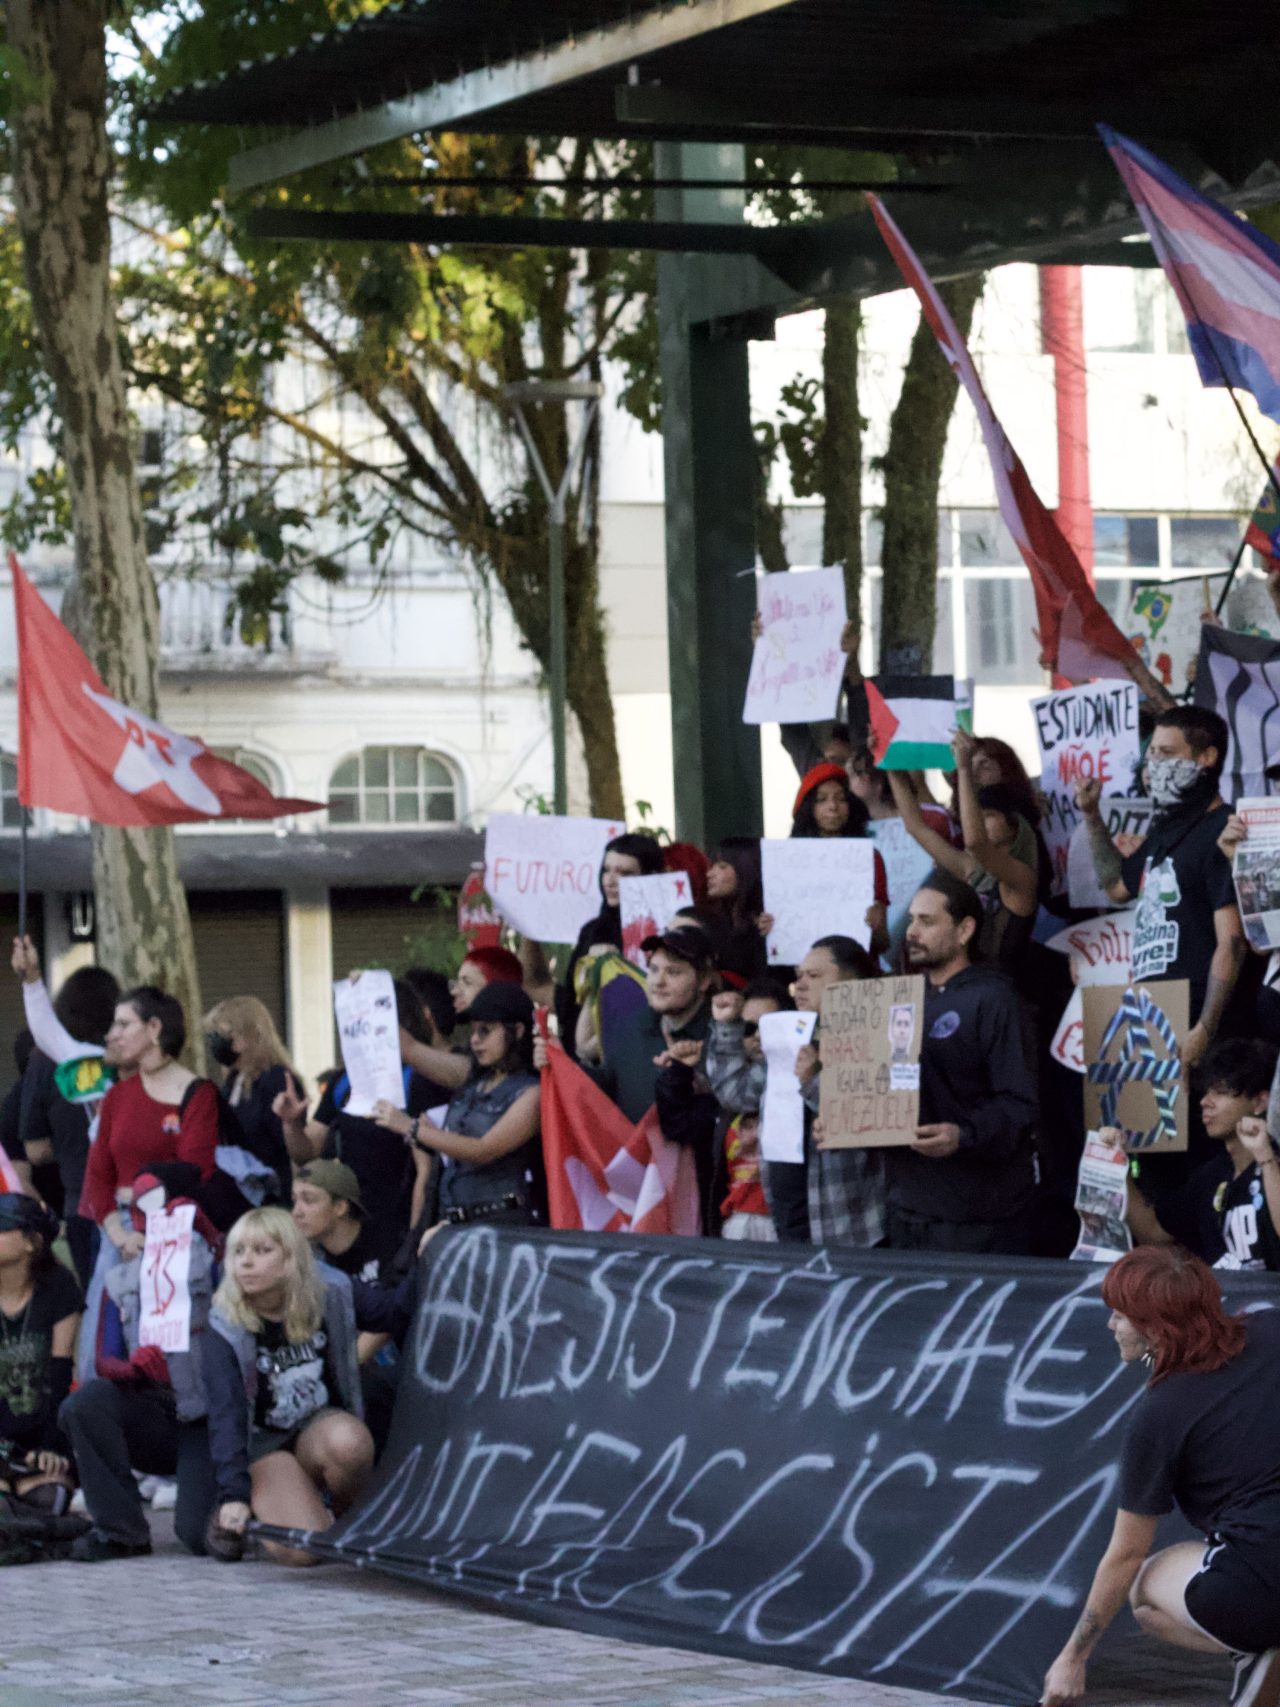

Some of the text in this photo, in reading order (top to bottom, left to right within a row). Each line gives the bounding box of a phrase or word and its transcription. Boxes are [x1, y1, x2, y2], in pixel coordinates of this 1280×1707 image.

[124, 716, 174, 766] PT
[1035, 685, 1136, 750] ESTUDANTE
[1058, 738, 1113, 785] NÃO É
[493, 856, 594, 895] FUTURO
[826, 978, 884, 1010] TRUMP
[476, 1244, 1015, 1422] RESISTÊNCIA
